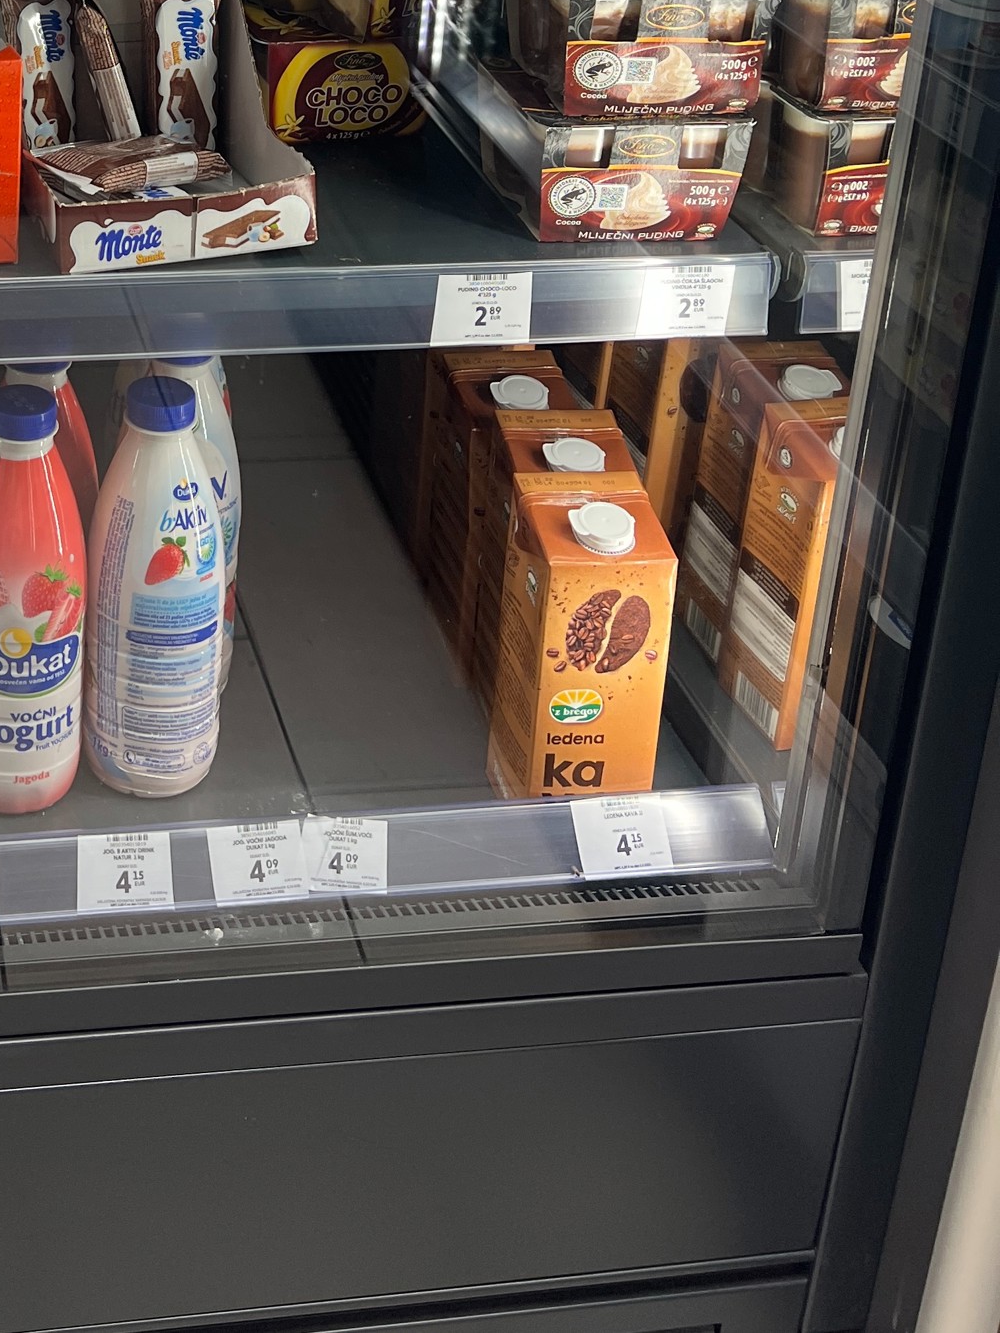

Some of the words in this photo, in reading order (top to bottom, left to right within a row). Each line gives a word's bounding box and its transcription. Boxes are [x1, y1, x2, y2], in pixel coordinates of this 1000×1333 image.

[176, 7, 206, 60] Monte
[306, 84, 403, 108] CHOCO
[580, 92, 607, 100] Cocoa
[314, 105, 389, 127] LOCO
[604, 104, 661, 114] MLIJEČNI
[666, 103, 714, 114] PUDING
[578, 230, 634, 240] MLIJEČNI
[637, 230, 684, 239] PUDING
[136, 249, 166, 266] Snack
[475, 306, 487, 326] 2
[489, 306, 501, 315] 89
[10, 706, 57, 724] VOĆNI
[563, 706, 600, 720] bregov
[546, 730, 605, 746] ledena
[35, 743, 51, 752] Fruit
[13, 770, 50, 785] Jagoda
[543, 753, 606, 788] ka
[250, 860, 265, 883] 4
[266, 859, 279, 869] 09
[115, 870, 131, 893] 4
[133, 870, 144, 880] 15
